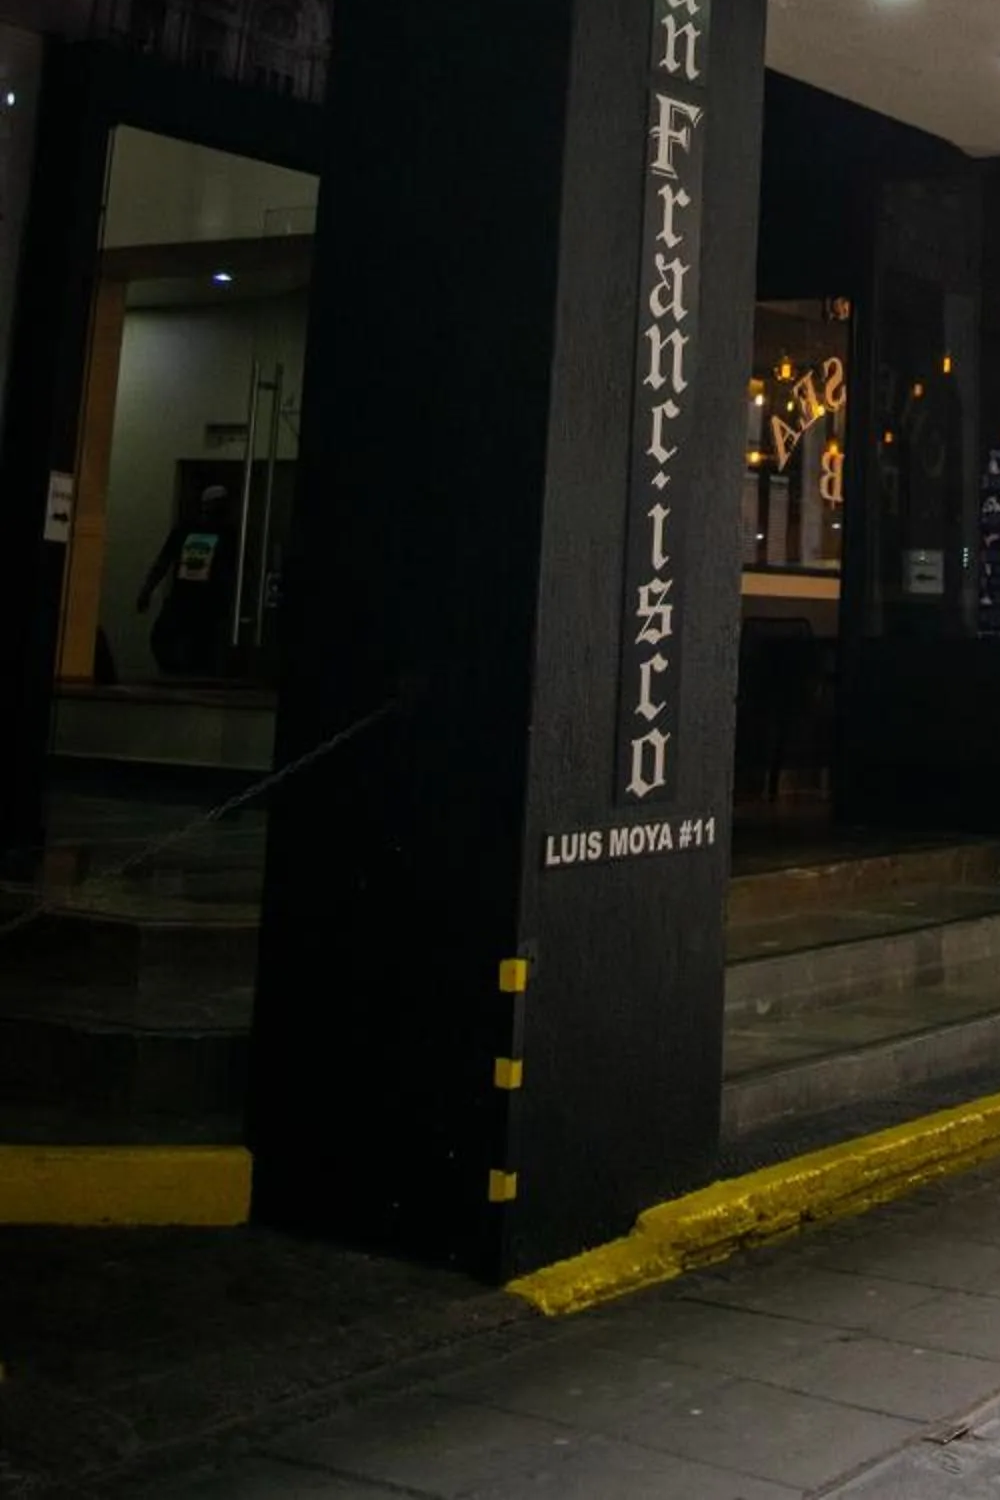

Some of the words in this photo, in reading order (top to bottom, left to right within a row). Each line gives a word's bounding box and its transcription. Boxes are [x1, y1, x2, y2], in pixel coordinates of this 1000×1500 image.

[546, 831, 603, 866] LUIS
[609, 822, 673, 857] MOYA
[679, 817, 716, 849] #11
